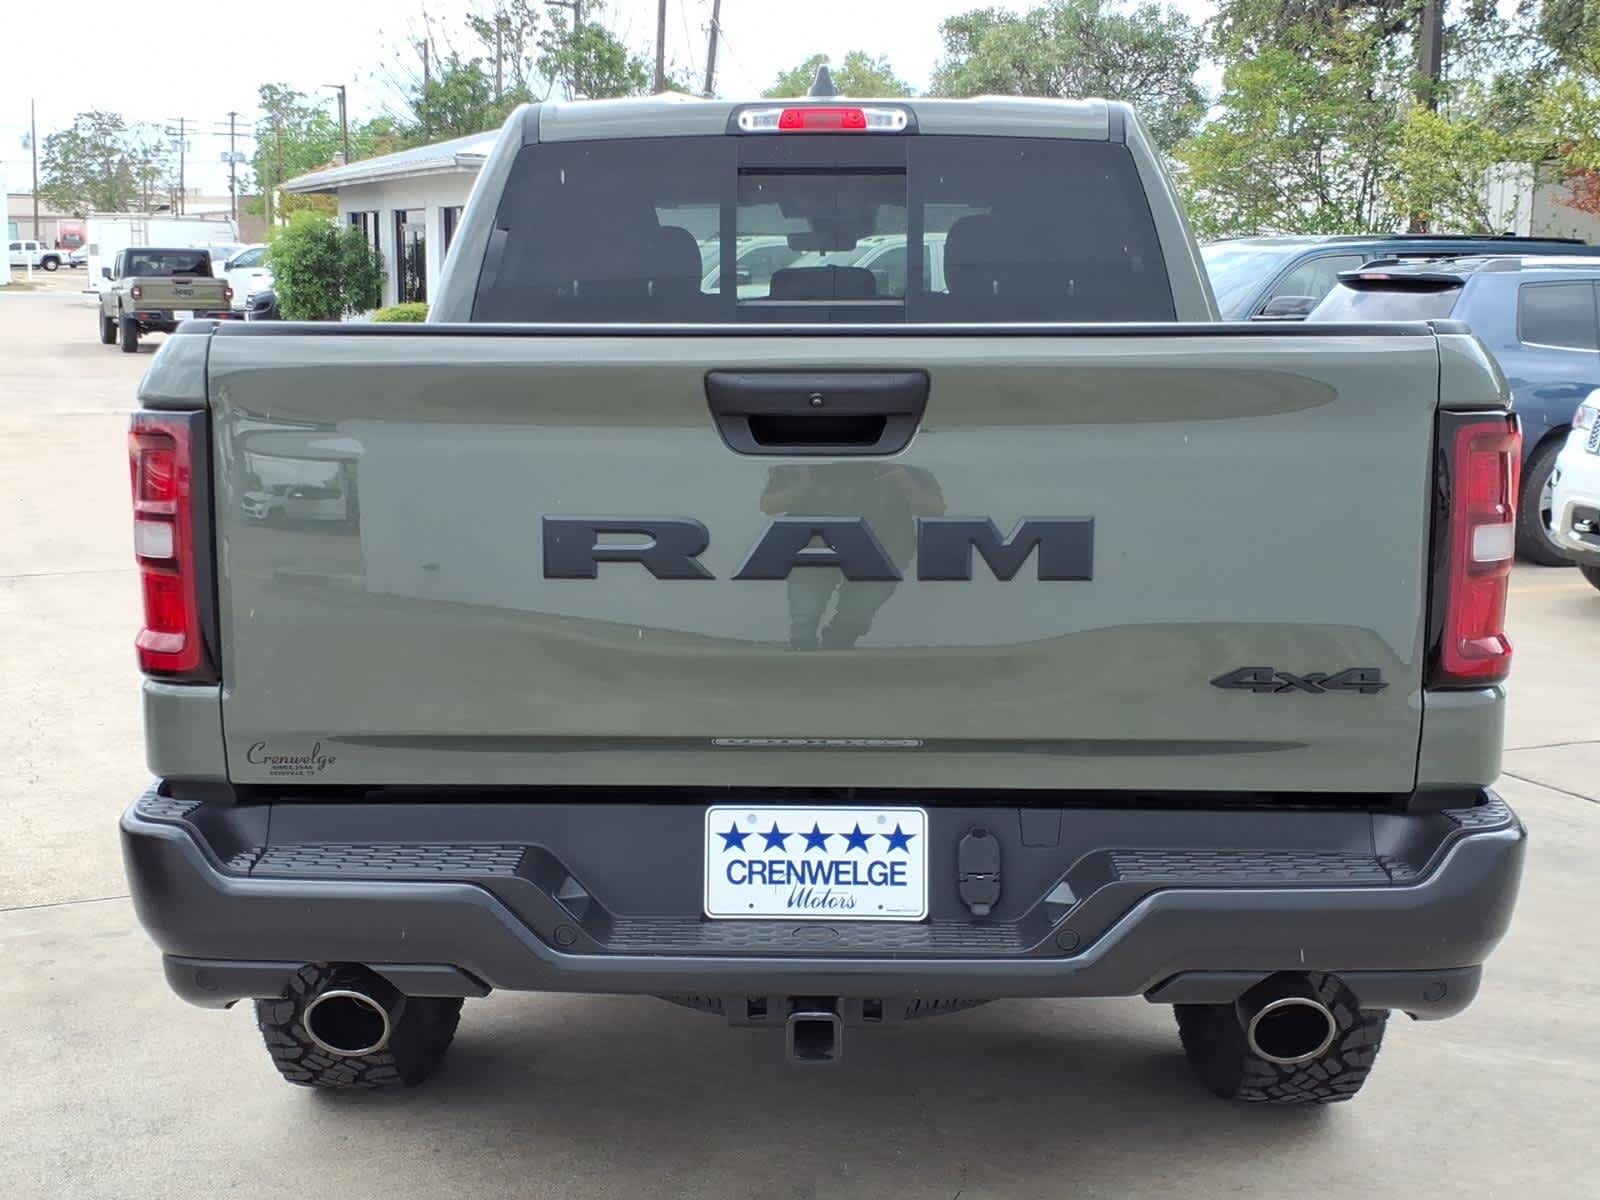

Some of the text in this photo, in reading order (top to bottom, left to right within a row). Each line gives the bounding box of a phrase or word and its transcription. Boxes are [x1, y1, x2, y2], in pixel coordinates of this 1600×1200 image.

[543, 515, 1094, 581] RAM
[1210, 667, 1390, 693] 4x4
[247, 741, 336, 771] Crenwelge
[726, 859, 908, 886] CRENWELGE
[786, 886, 857, 909] Motors
